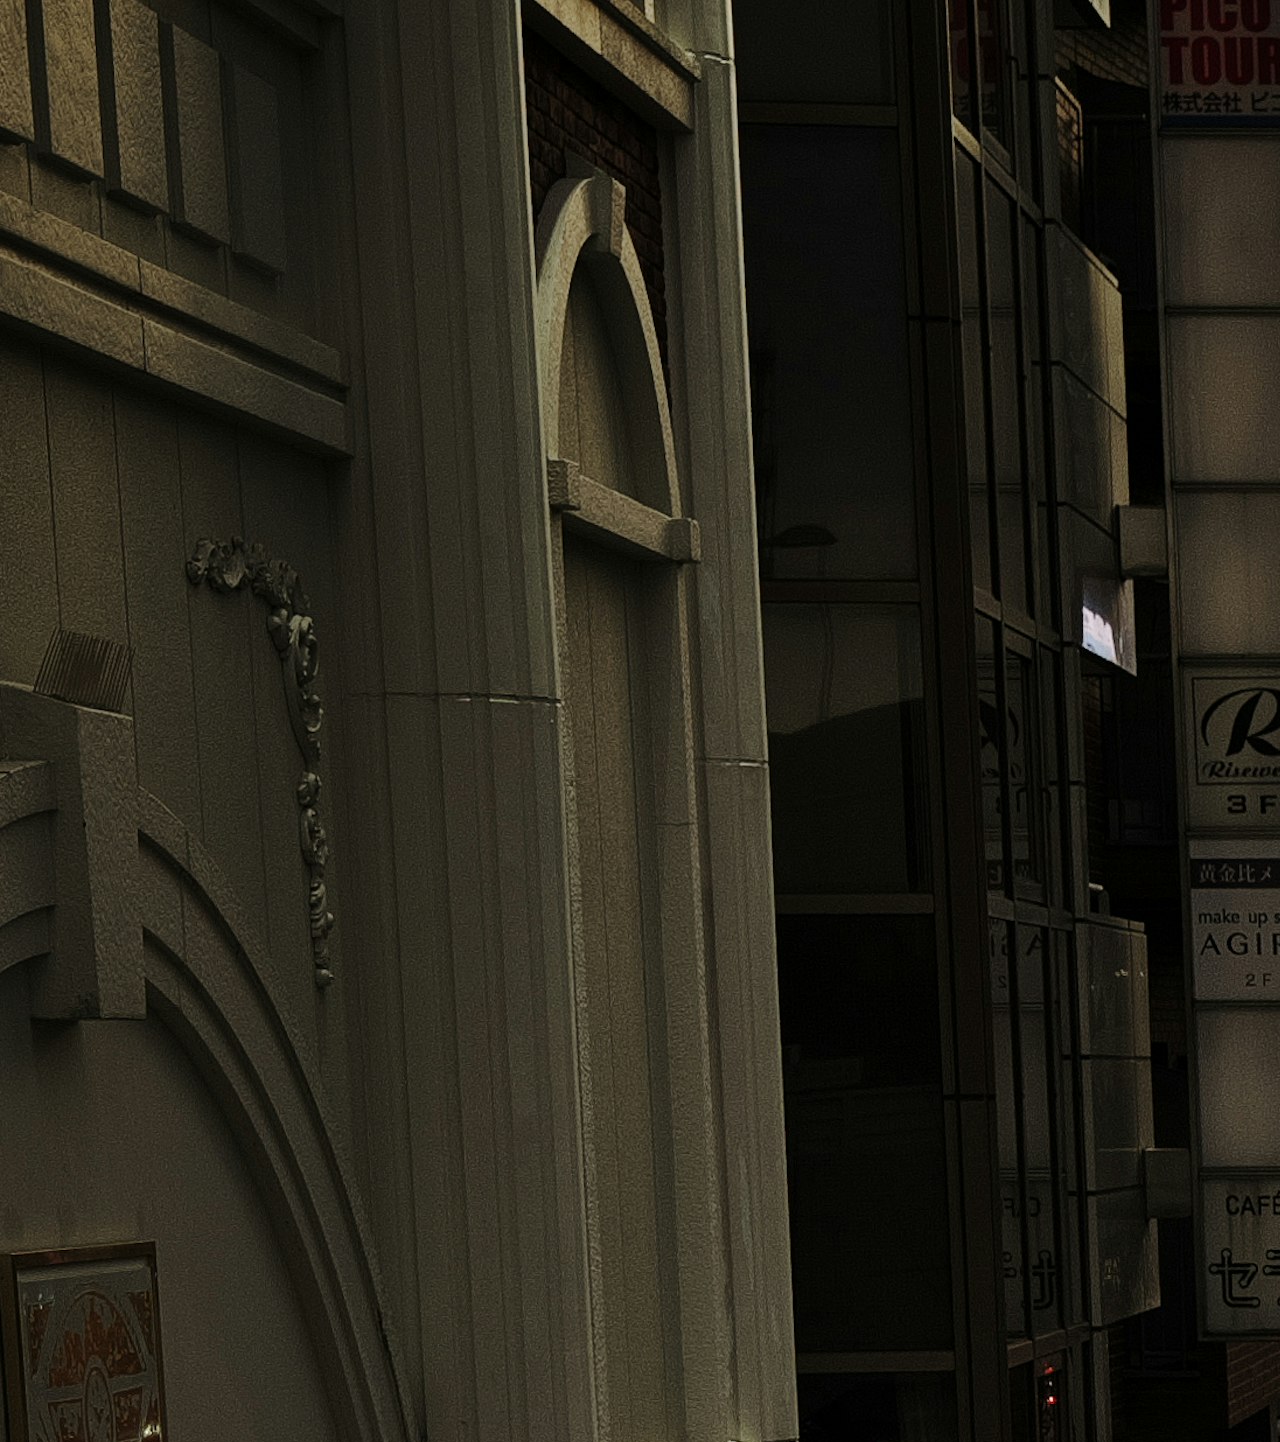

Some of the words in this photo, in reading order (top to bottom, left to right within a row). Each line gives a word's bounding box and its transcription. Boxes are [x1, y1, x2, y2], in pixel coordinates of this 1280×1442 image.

[1161, 0, 1270, 32] PICO
[1163, 92, 1242, 113] 株式会社
[1199, 908, 1240, 924] make
[1248, 911, 1268, 928] up
